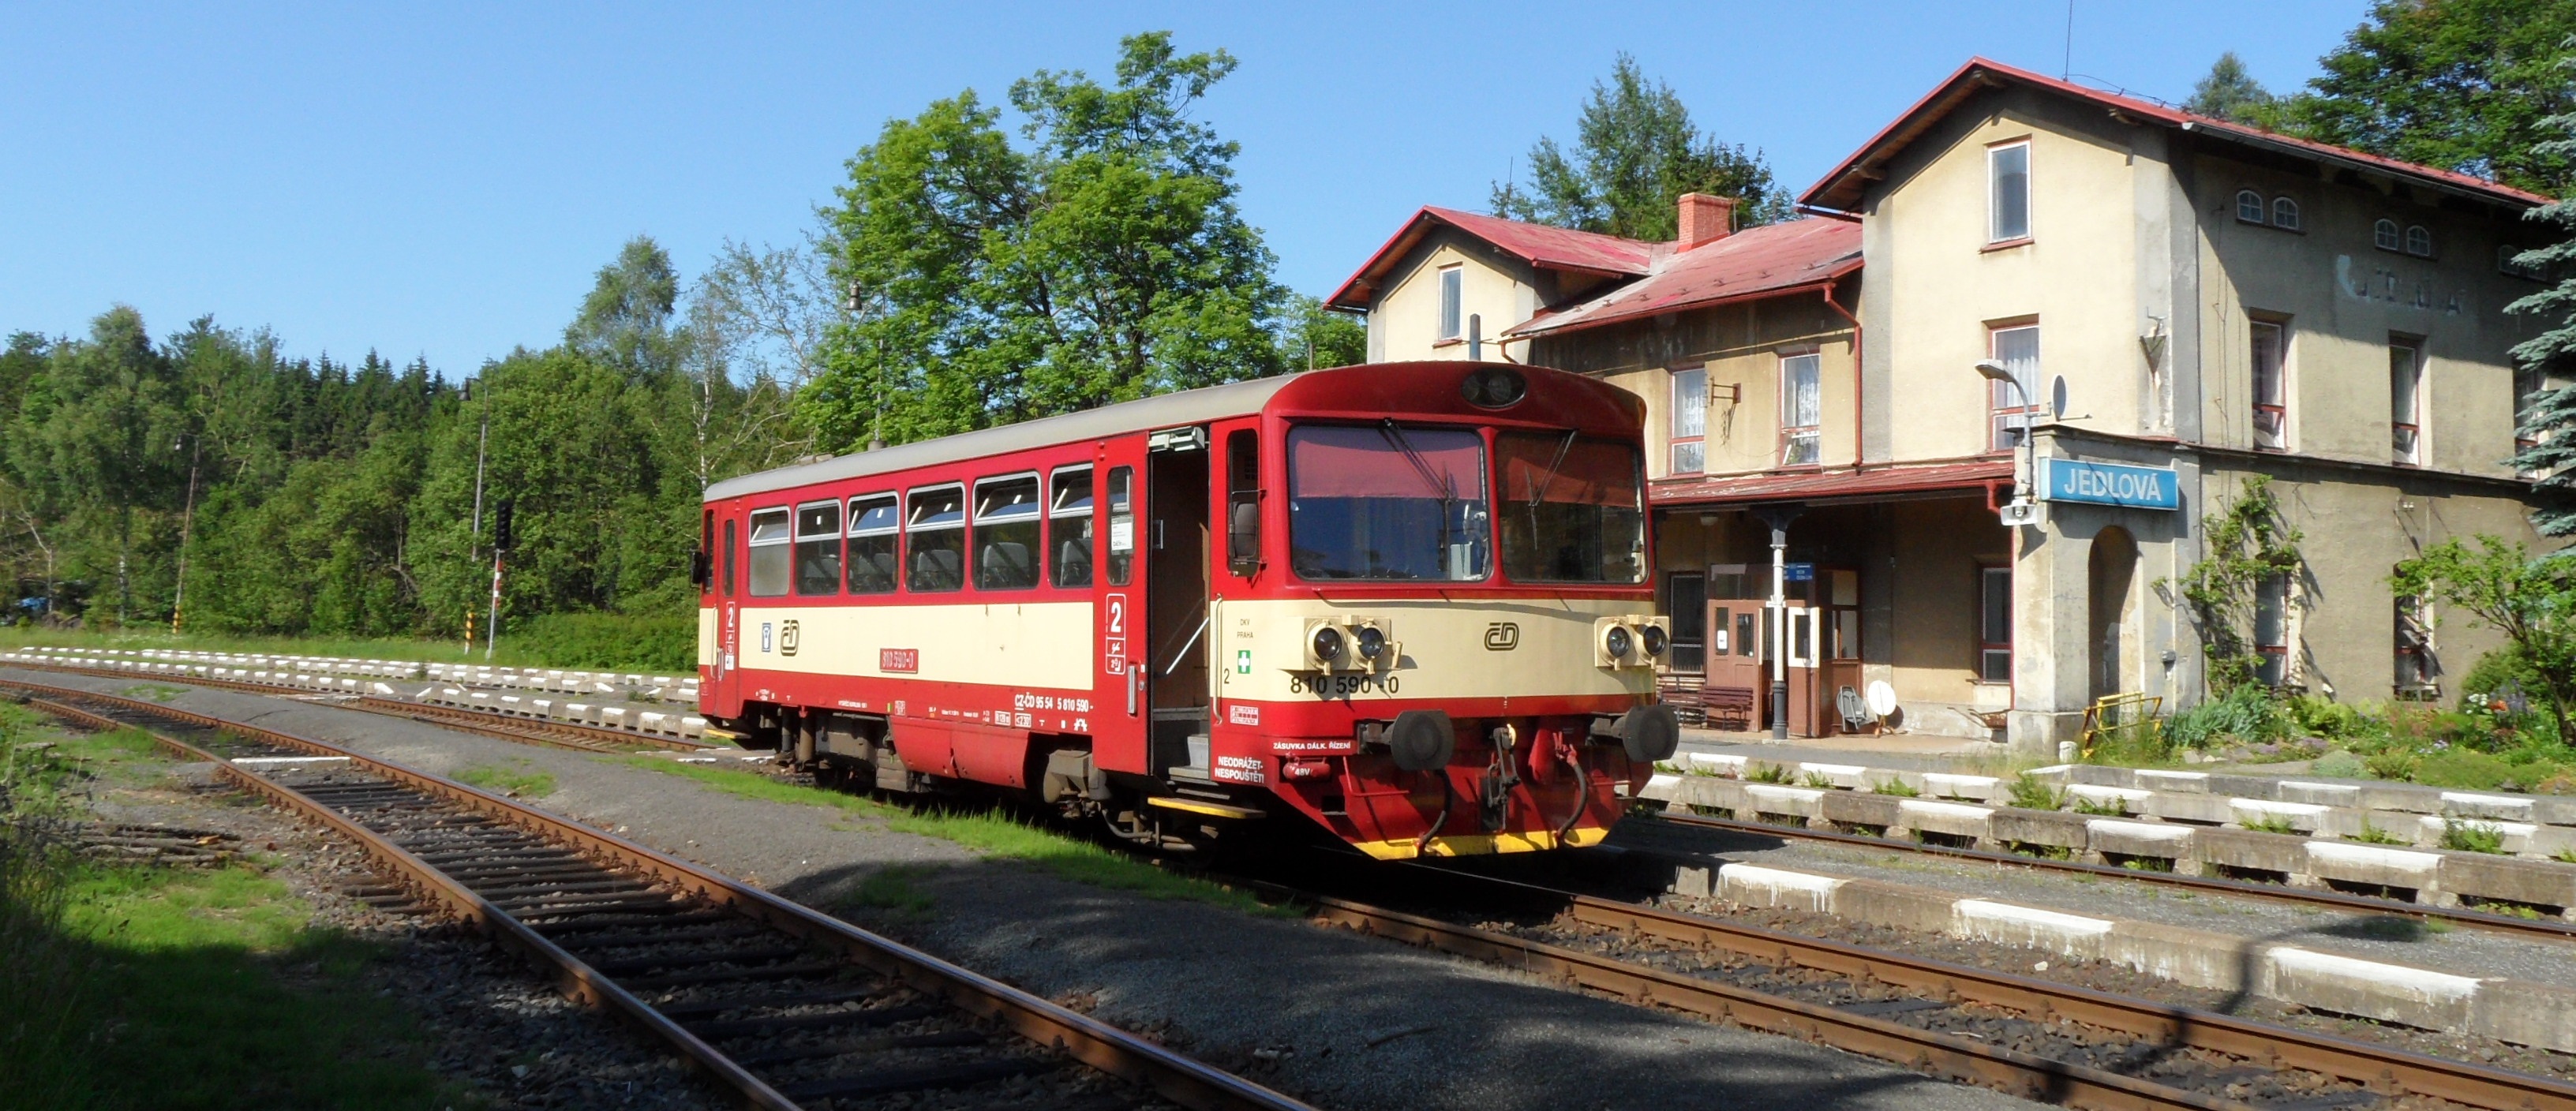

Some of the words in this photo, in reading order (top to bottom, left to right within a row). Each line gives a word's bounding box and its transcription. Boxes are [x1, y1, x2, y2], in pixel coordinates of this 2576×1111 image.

[2064, 468, 2162, 502] JEDLOVÁ
[727, 607, 734, 628] 2
[1110, 601, 1122, 633] 2
[1223, 668, 1230, 684] 2
[1290, 675, 1328, 694] 810
[1035, 696, 1044, 709] 95
[1044, 697, 1054, 709] 54
[1057, 698, 1062, 710] 5
[1063, 698, 1075, 712] 810
[1273, 741, 1305, 750] ZÁSUVKA
[1328, 740, 1351, 750] ŘÍZENÍ
[1294, 767, 1311, 776] 48V
